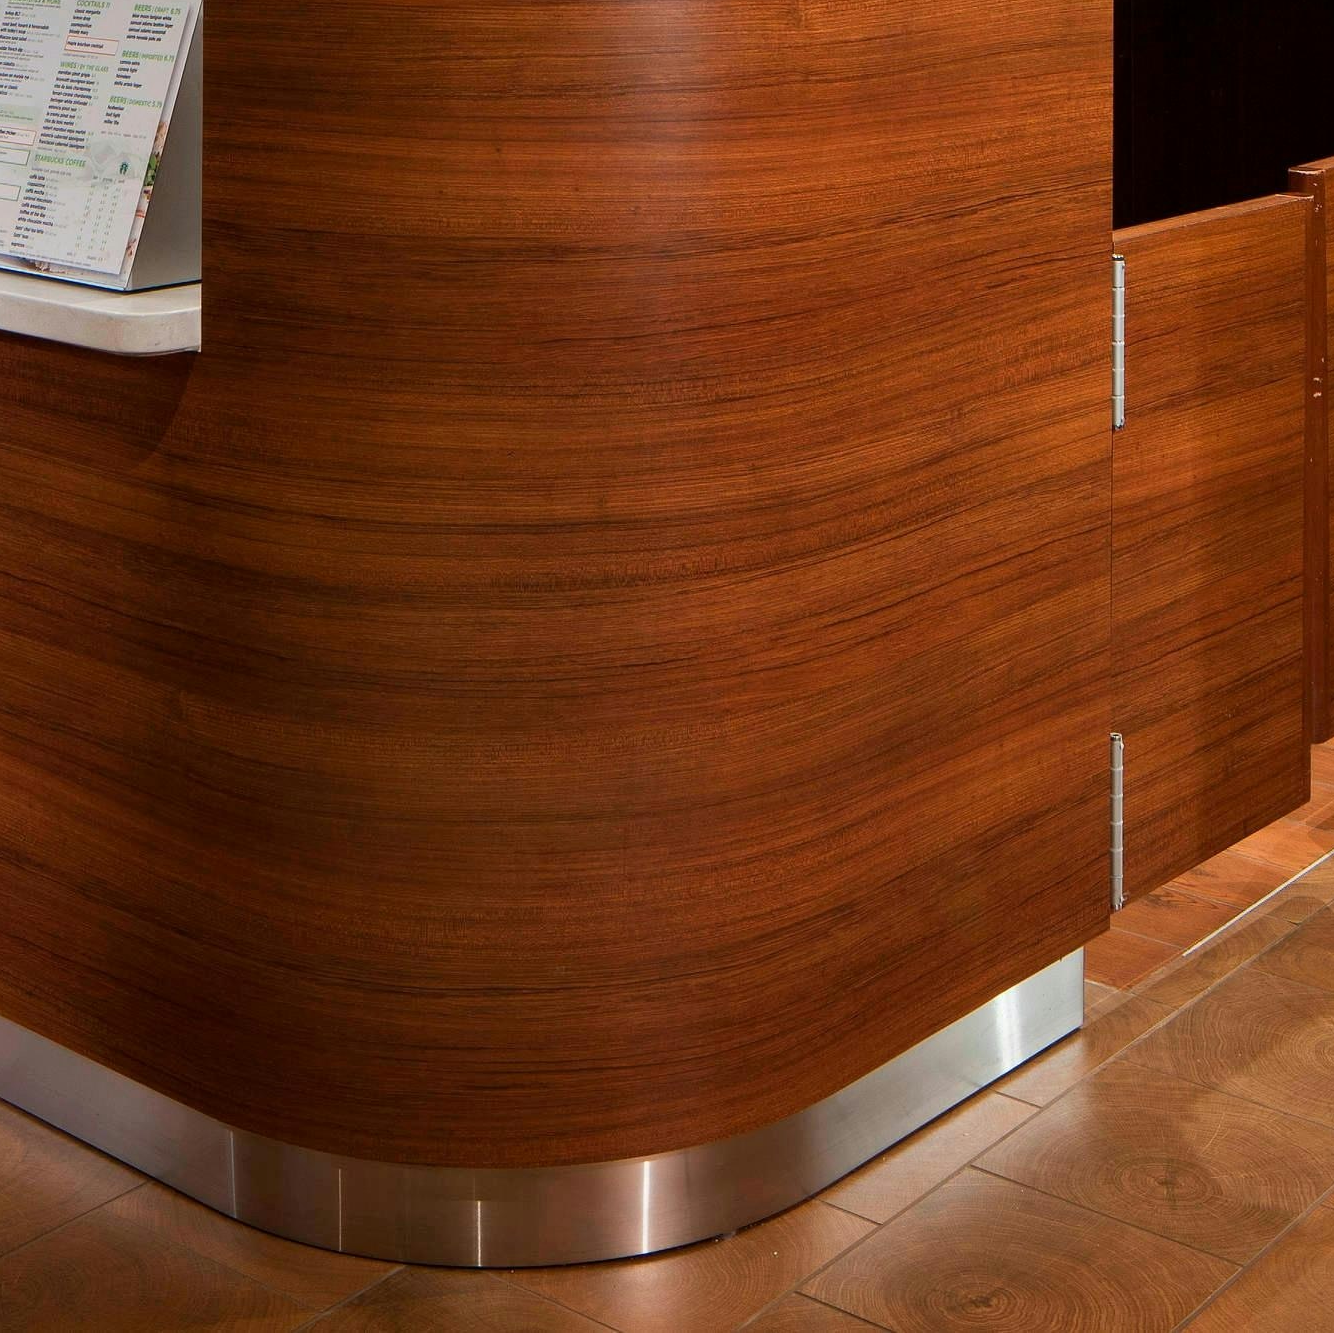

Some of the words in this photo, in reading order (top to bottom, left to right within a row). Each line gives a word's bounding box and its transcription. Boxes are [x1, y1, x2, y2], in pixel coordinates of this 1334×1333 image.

[76, 0, 105, 8] COCKTAILS
[134, 4, 152, 12] BEERS
[121, 50, 139, 58] BEERS
[65, 157, 86, 167] COFFEE
